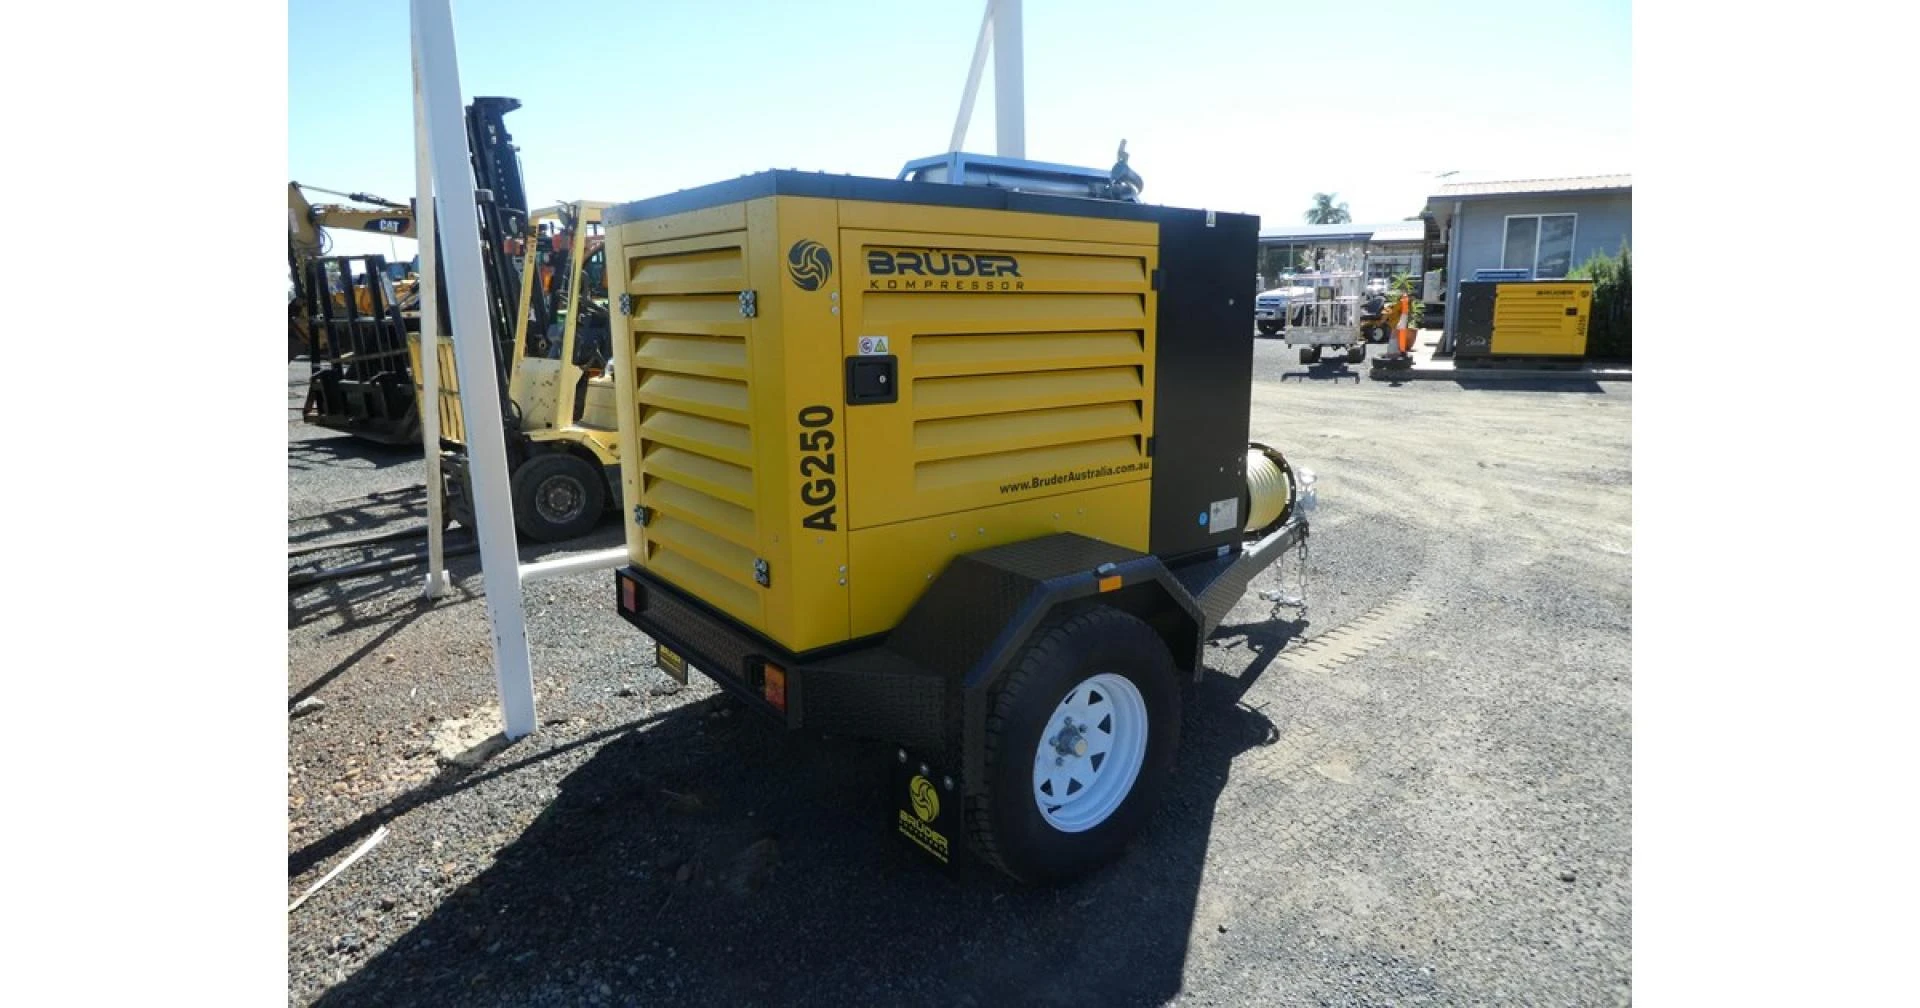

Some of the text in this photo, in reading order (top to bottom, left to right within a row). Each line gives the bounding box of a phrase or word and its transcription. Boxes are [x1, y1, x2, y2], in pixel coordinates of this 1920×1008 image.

[380, 219, 399, 232] CAT
[868, 249, 1023, 277] BRÜDER
[870, 279, 1024, 290] KOMPRESSOR
[798, 405, 837, 531] AG250
[1000, 461, 1149, 494] www.BruderAustralia.com.au
